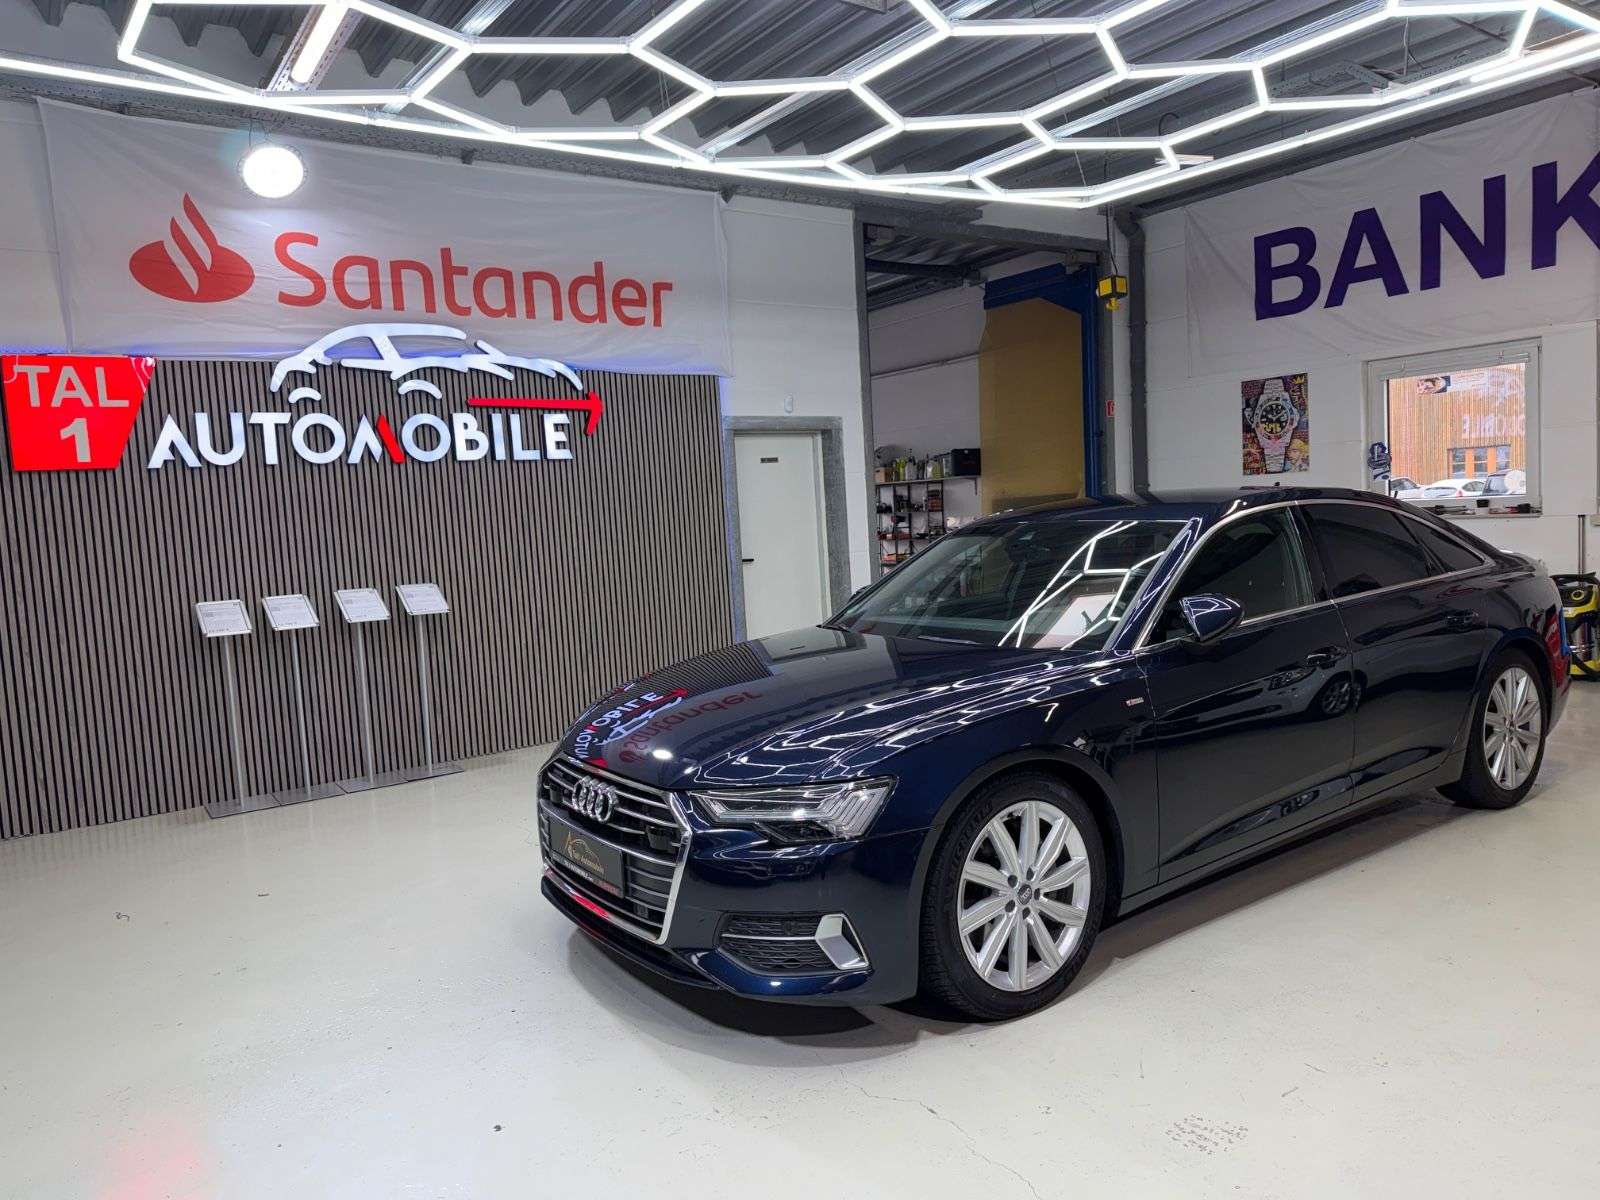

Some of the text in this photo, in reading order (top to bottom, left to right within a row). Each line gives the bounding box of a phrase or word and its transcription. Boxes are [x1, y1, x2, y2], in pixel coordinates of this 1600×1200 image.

[1253, 150, 1600, 321] BANK
[274, 231, 674, 328] Santander
[13, 364, 130, 408] TAL
[60, 417, 92, 463] 1
[147, 411, 574, 470] AUTOMOBILE
